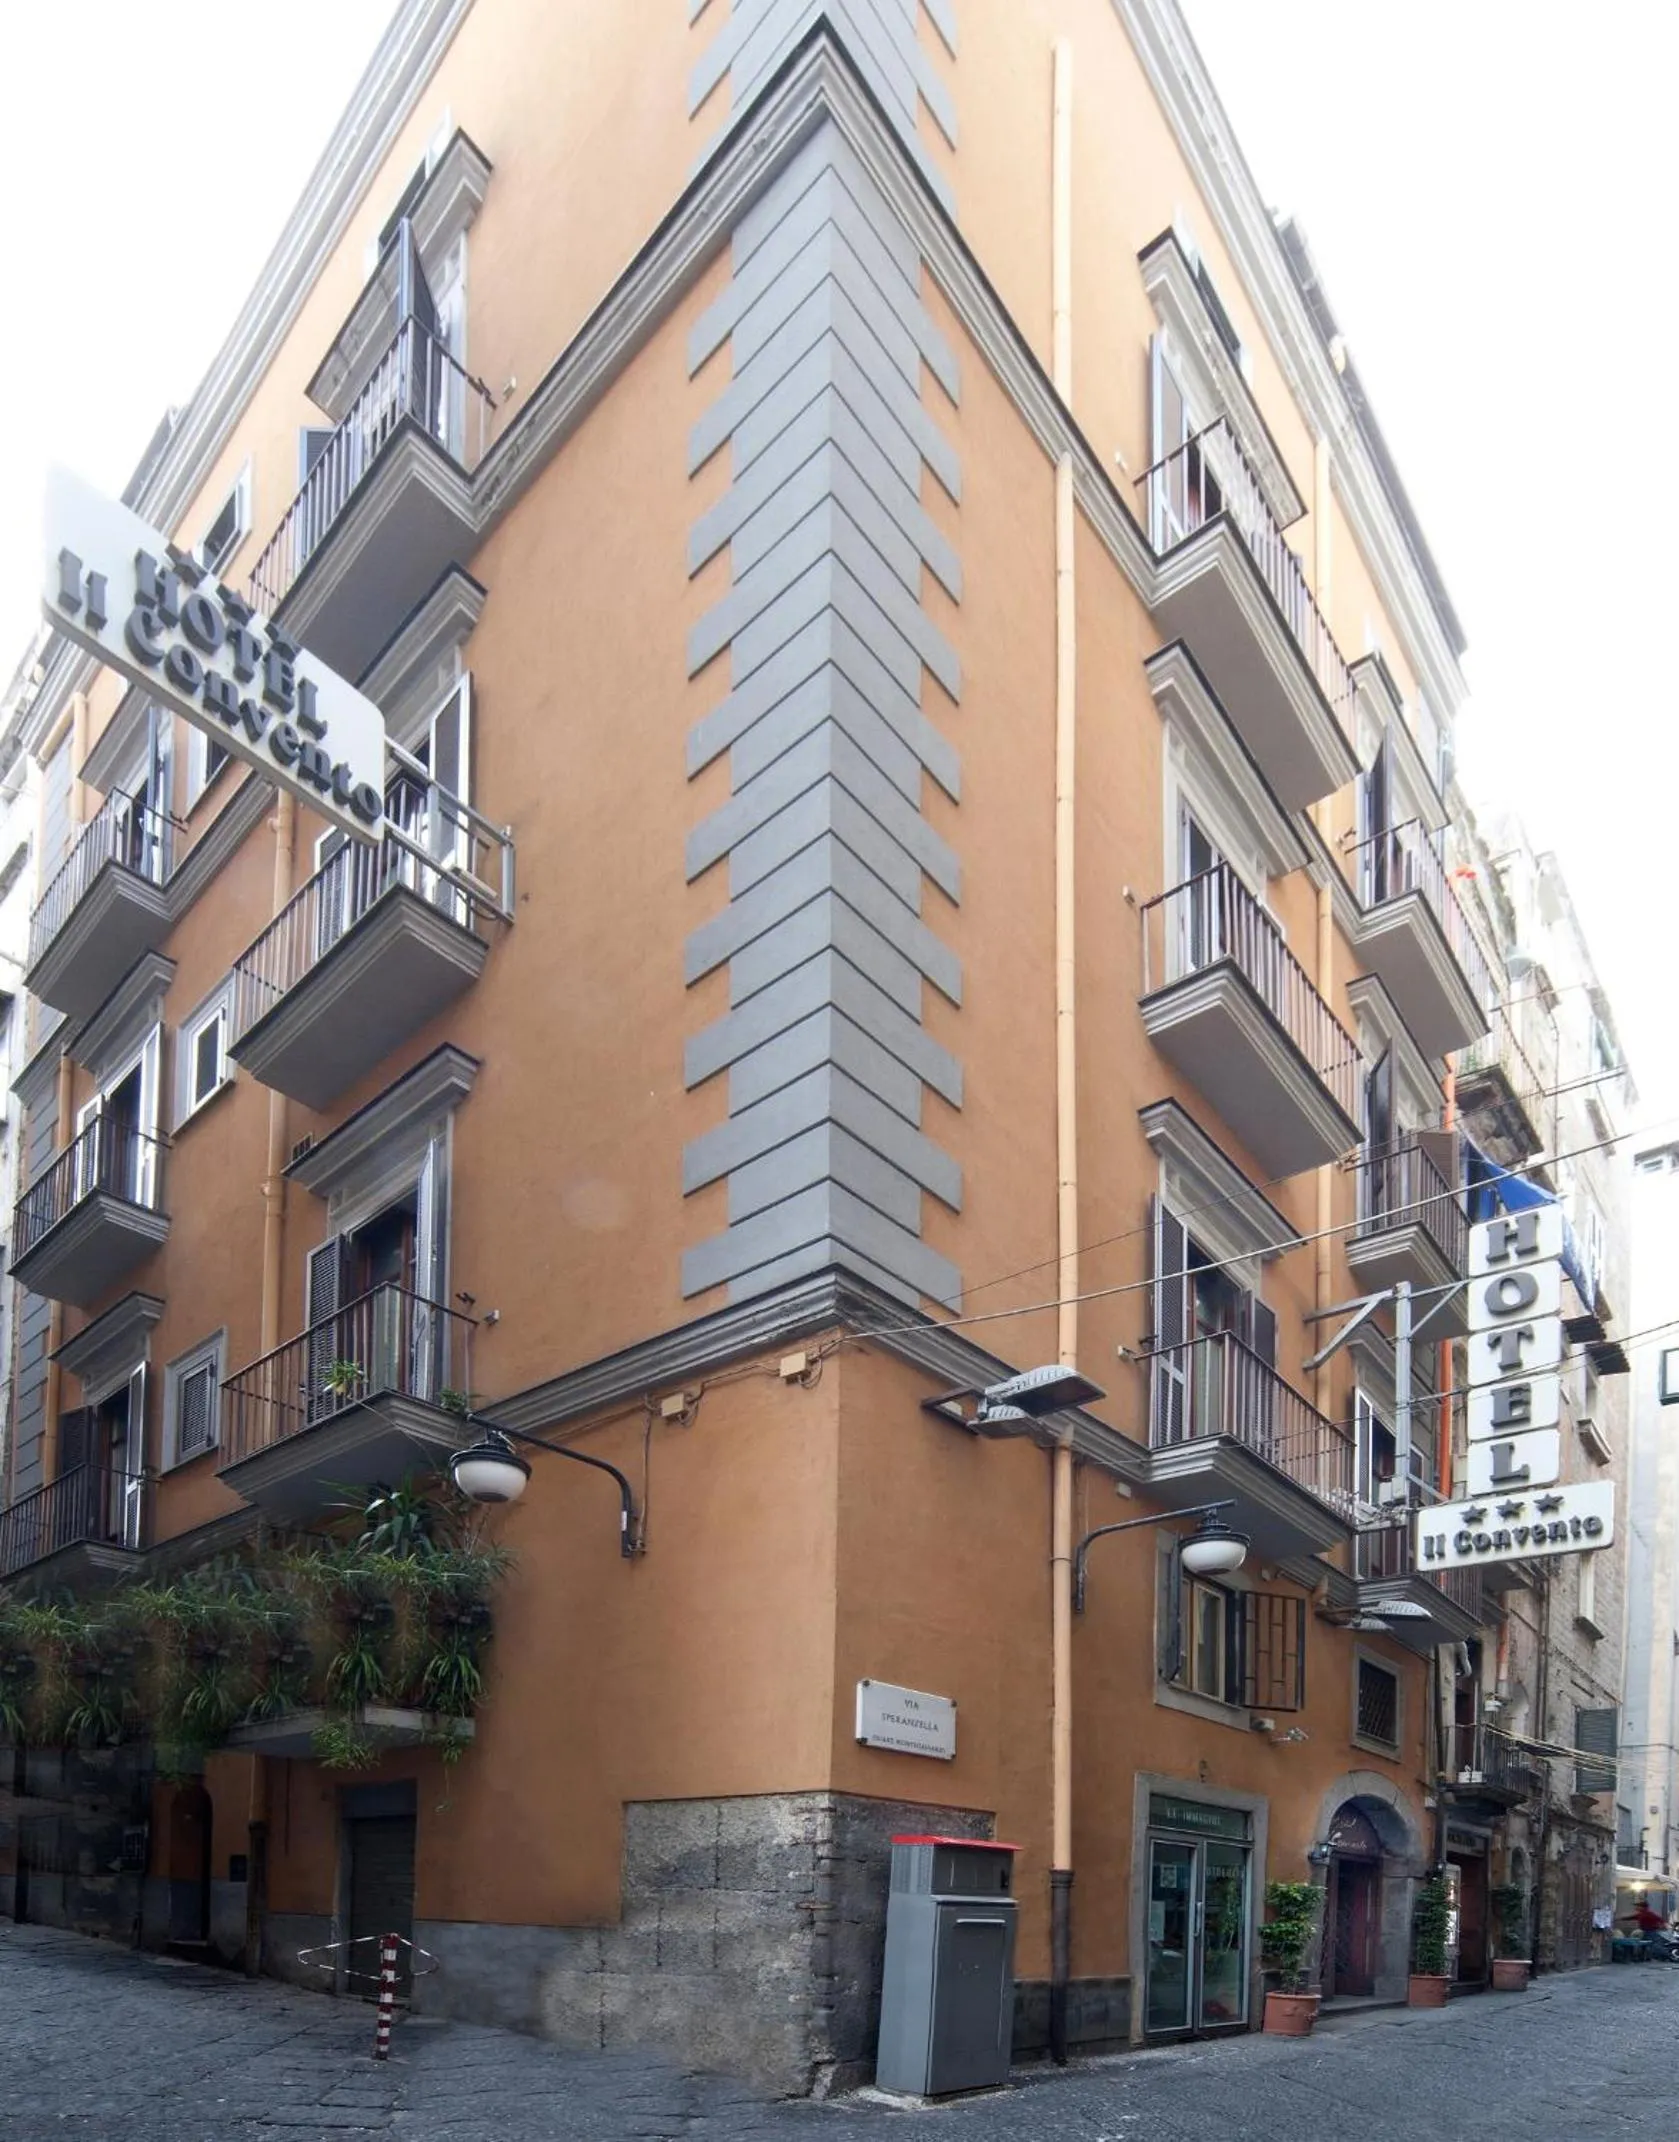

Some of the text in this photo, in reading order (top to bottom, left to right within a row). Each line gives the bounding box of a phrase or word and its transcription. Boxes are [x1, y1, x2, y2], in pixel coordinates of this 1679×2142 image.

[124, 604, 383, 824] Convento
[134, 547, 328, 741] HOTEL
[1484, 1211, 1540, 1486] HOTEL
[1423, 1515, 1604, 1560] Il Convento
[904, 1699, 920, 1710] VIA
